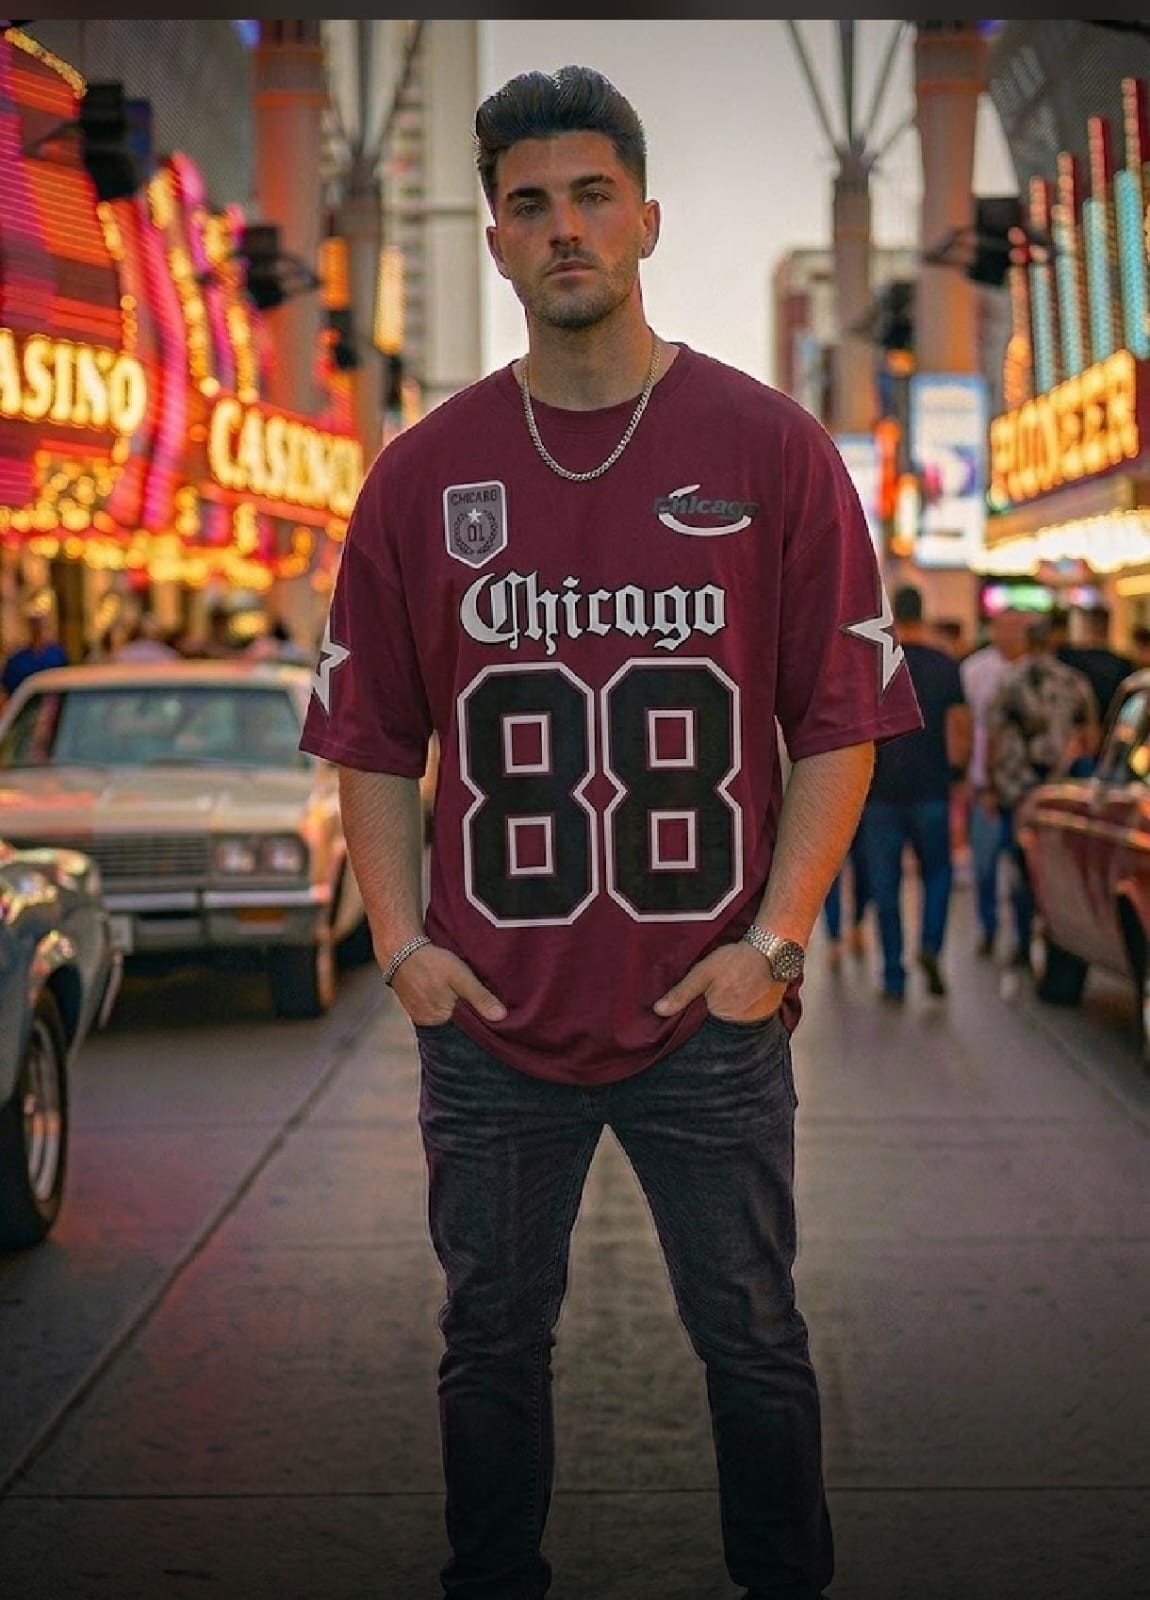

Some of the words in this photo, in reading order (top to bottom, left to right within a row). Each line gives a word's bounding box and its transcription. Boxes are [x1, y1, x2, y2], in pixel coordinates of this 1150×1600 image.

[209, 397, 364, 519] CASINO
[459, 570, 727, 656] Chicago
[457, 657, 743, 927] 88
